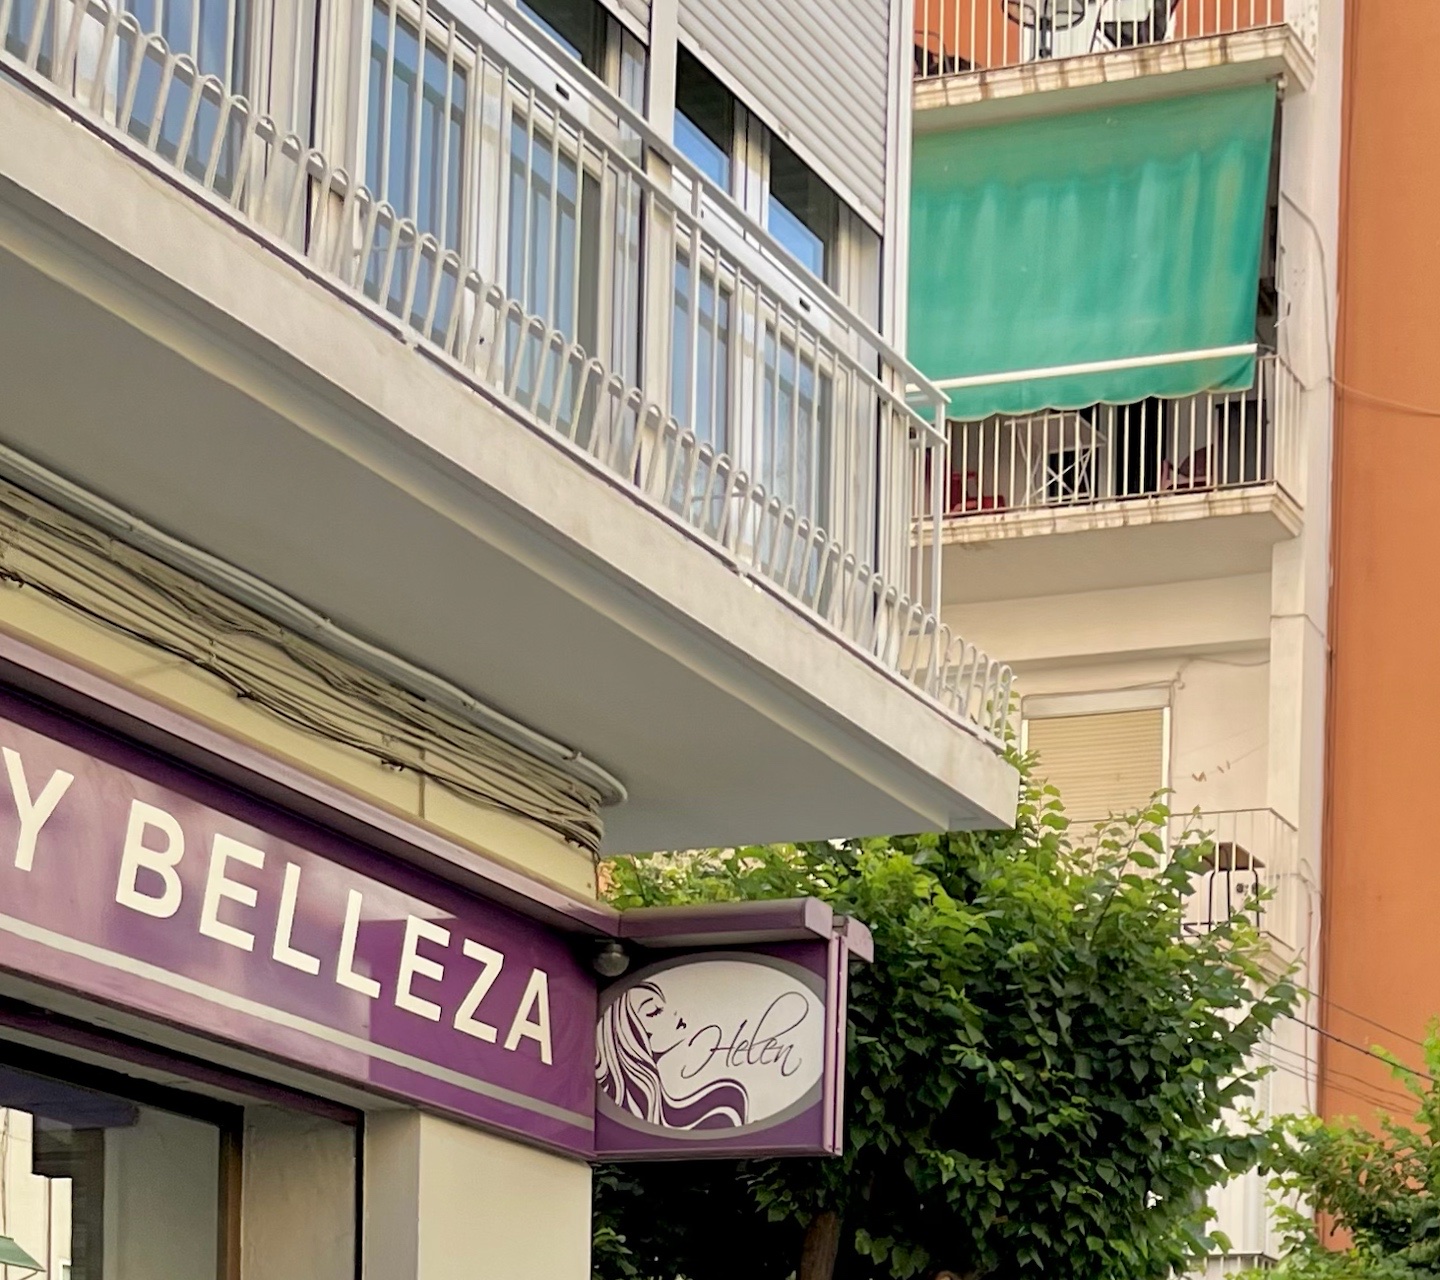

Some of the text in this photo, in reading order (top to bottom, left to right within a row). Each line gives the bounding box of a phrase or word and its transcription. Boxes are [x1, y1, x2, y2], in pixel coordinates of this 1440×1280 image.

[3, 746, 555, 1067] Y BELLEZA
[681, 991, 809, 1079] Helen
